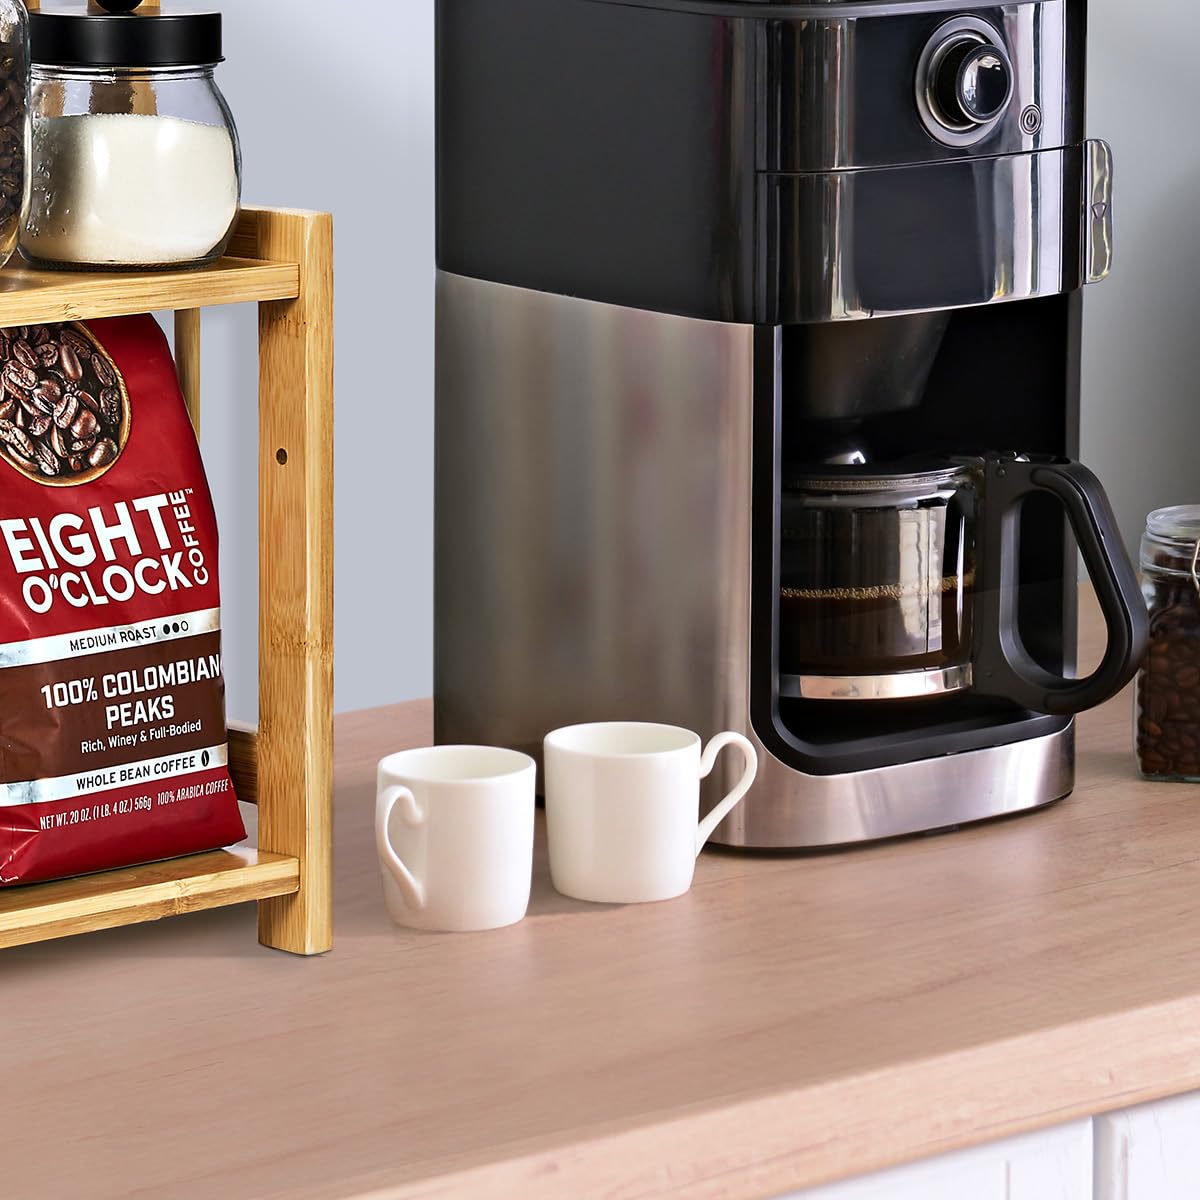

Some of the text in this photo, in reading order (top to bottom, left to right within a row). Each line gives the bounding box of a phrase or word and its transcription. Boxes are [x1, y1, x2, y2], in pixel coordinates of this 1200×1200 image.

[0, 493, 172, 574] EIGHT
[168, 489, 209, 585] COFFEE
[22, 551, 193, 614] O'CLOCK
[69, 625, 157, 651] MEDIUM ROAST
[40, 654, 220, 709] 100% COLOMBIAN
[81, 718, 202, 754] Rich, Winey & Full-Bodied
[105, 695, 175, 730] PEAKS
[76, 755, 196, 790] WHOLE BEAN COFFEE
[39, 815, 56, 830] NET
[56, 812, 69, 827] WT.
[69, 811, 80, 824] 20
[80, 808, 92, 822] OZ.
[100, 805, 111, 818] LB.
[118, 800, 133, 814] OZ.)
[134, 797, 152, 811] 566g
[157, 791, 176, 806] 100%
[176, 784, 204, 802] ARABICA
[205, 778, 229, 795] COFFEE
